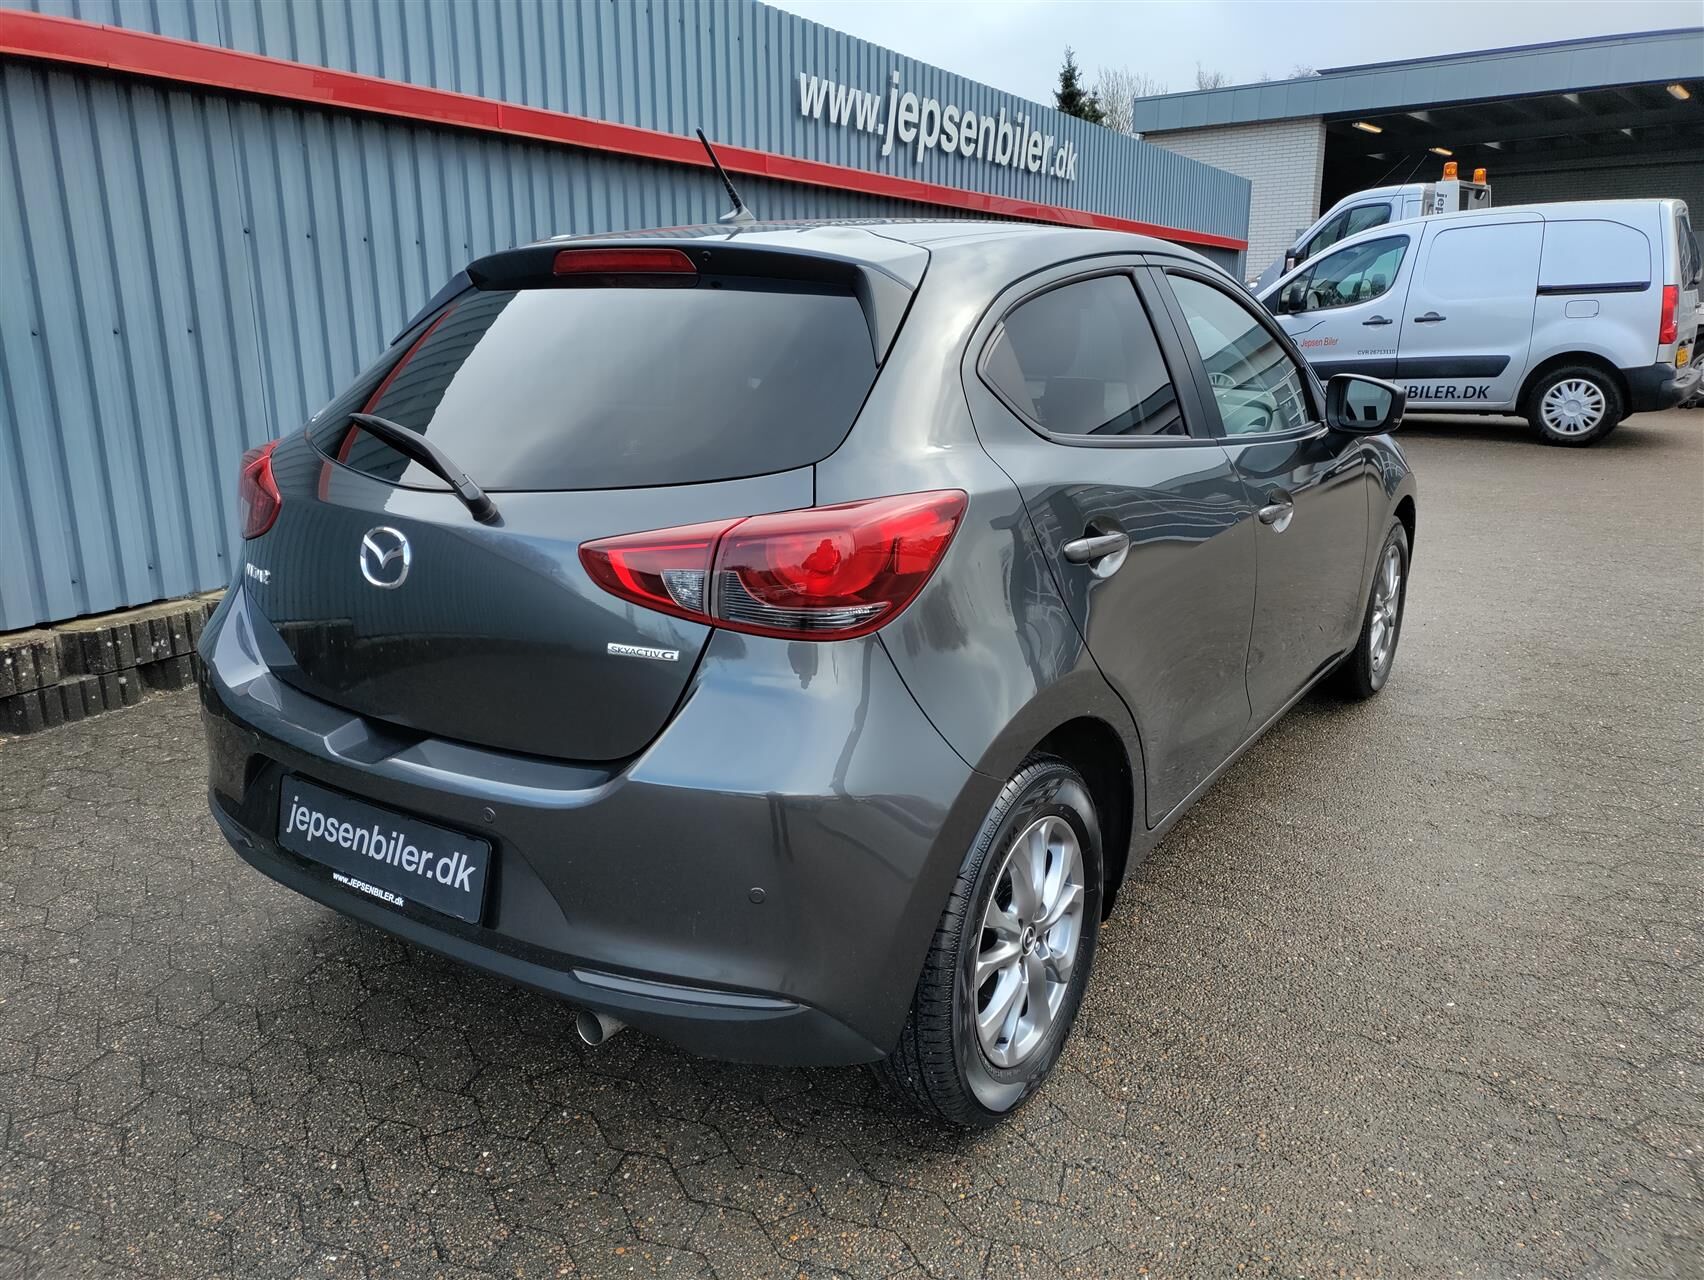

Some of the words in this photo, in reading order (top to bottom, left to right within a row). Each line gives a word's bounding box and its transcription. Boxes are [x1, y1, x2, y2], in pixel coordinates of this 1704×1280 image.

[799, 71, 1077, 181] www.jepsenbiler.dk
[1301, 338, 1322, 348] Jepsen
[1323, 336, 1338, 346] Biler
[1404, 385, 1490, 399] BILER.DK
[286, 796, 476, 892] jepsenbiler.dk
[332, 872, 404, 906] www.JEPSENBILER.dk
